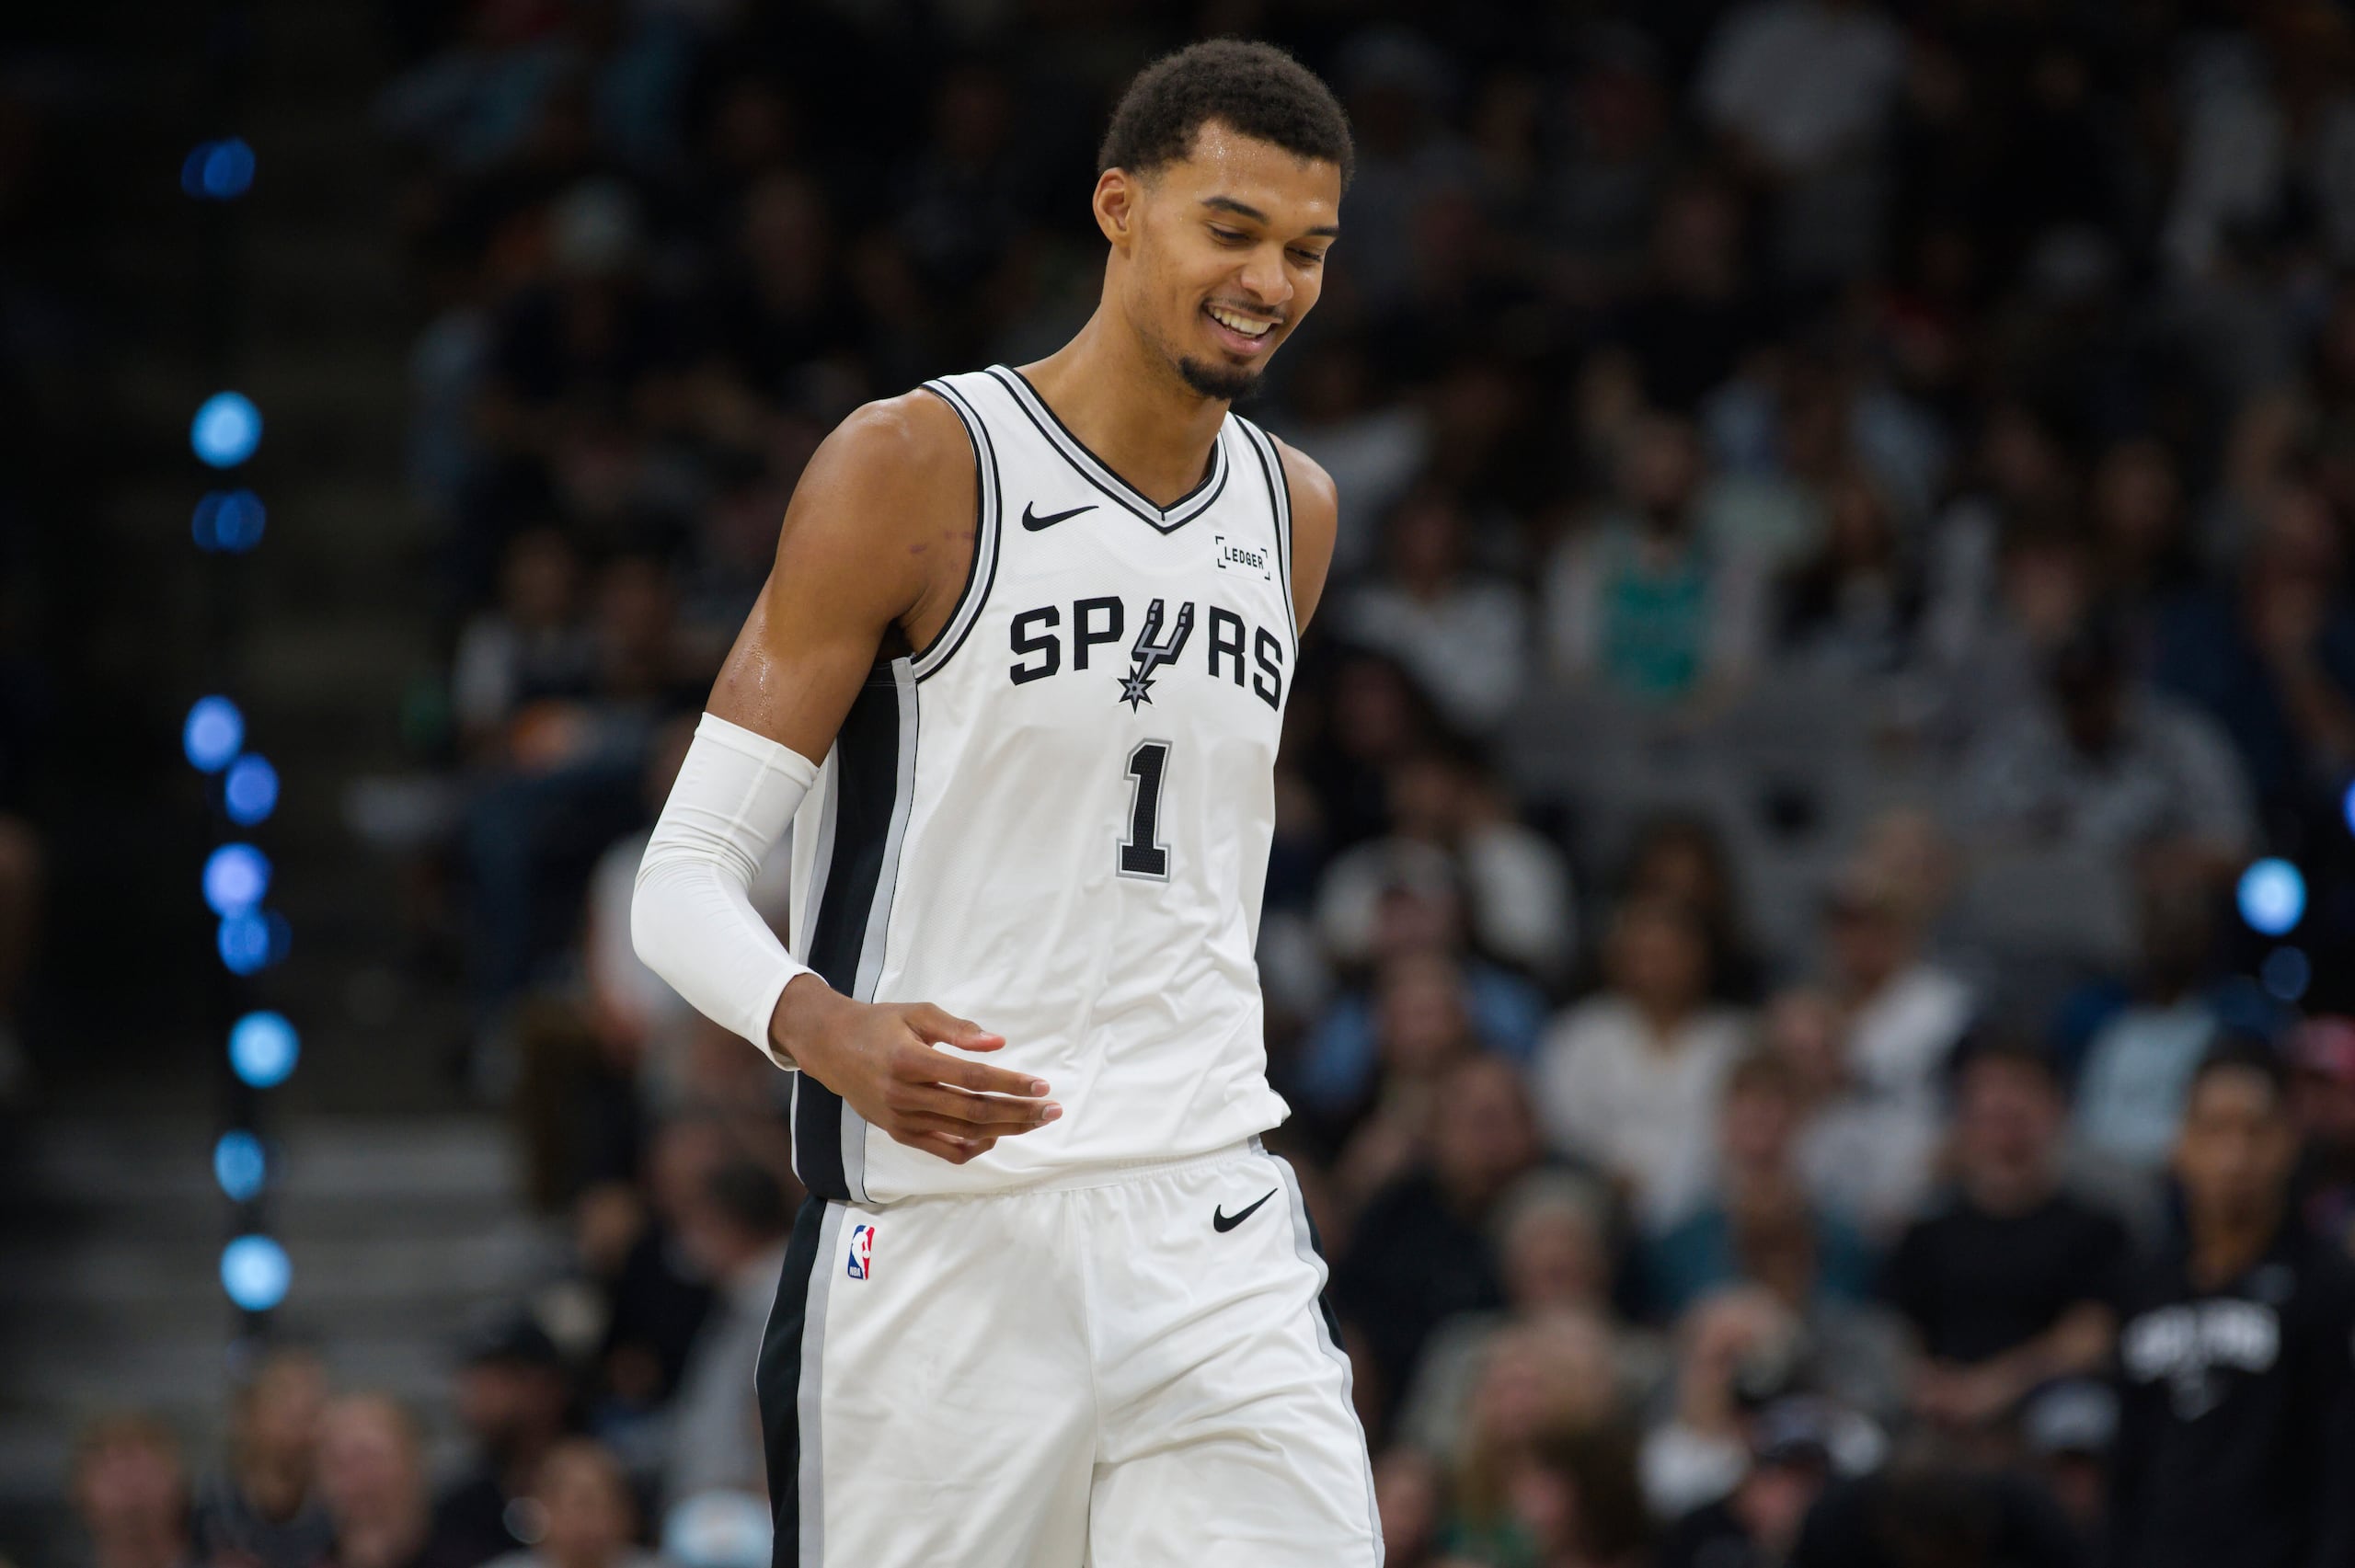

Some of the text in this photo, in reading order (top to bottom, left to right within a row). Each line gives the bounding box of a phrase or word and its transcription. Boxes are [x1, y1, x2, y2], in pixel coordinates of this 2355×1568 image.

[1224, 545, 1264, 570] LEDGER
[1010, 596, 1282, 715] SPURS
[1116, 738, 1173, 883] 1
[849, 1265, 861, 1277] NBA
